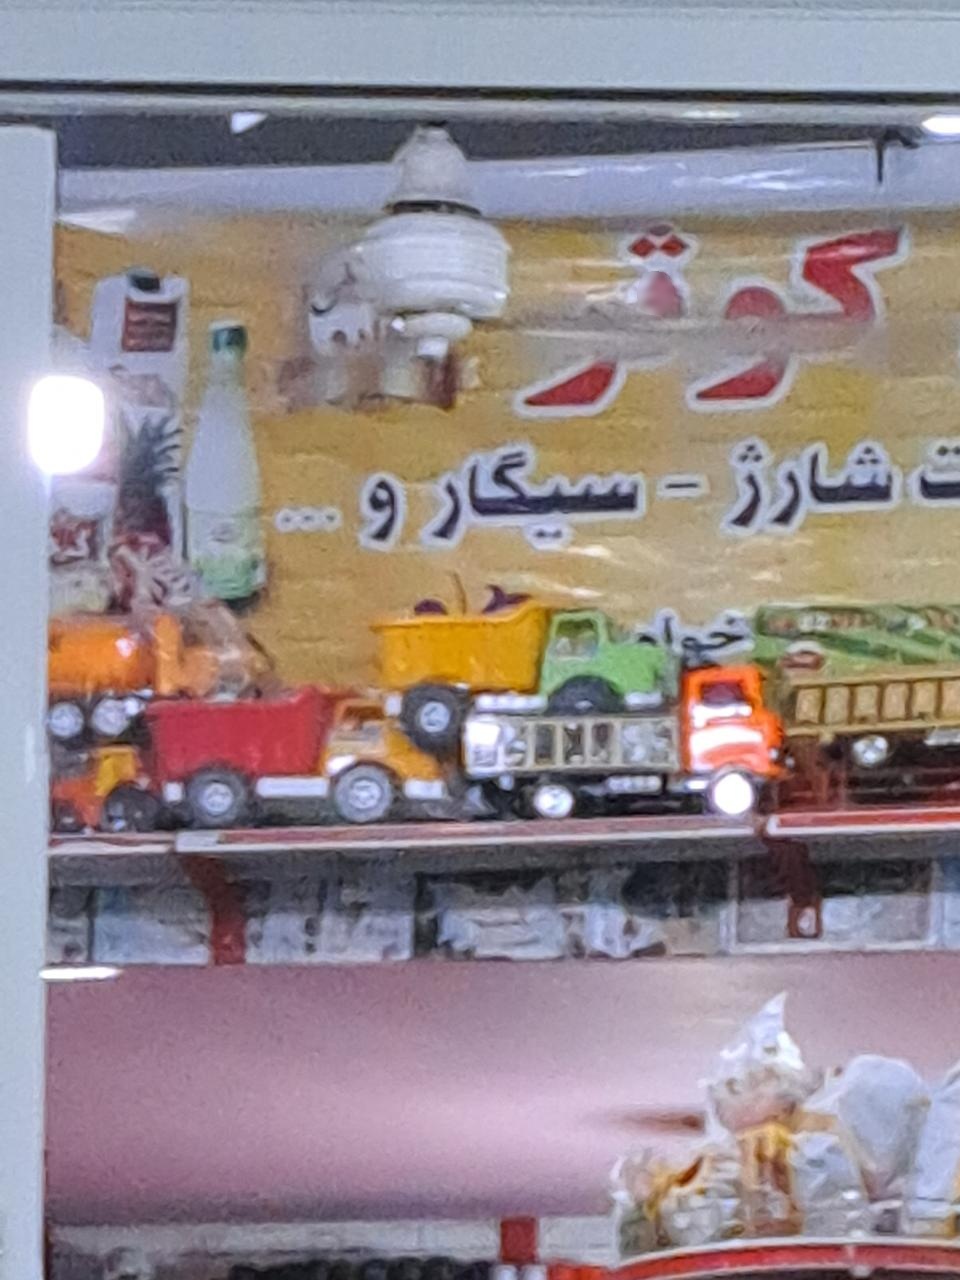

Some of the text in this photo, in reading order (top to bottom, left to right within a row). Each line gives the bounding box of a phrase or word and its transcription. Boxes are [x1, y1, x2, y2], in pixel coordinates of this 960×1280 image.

[367, 481, 396, 541] و
[426, 452, 639, 541] سیگار
[730, 444, 893, 526] شارژ
